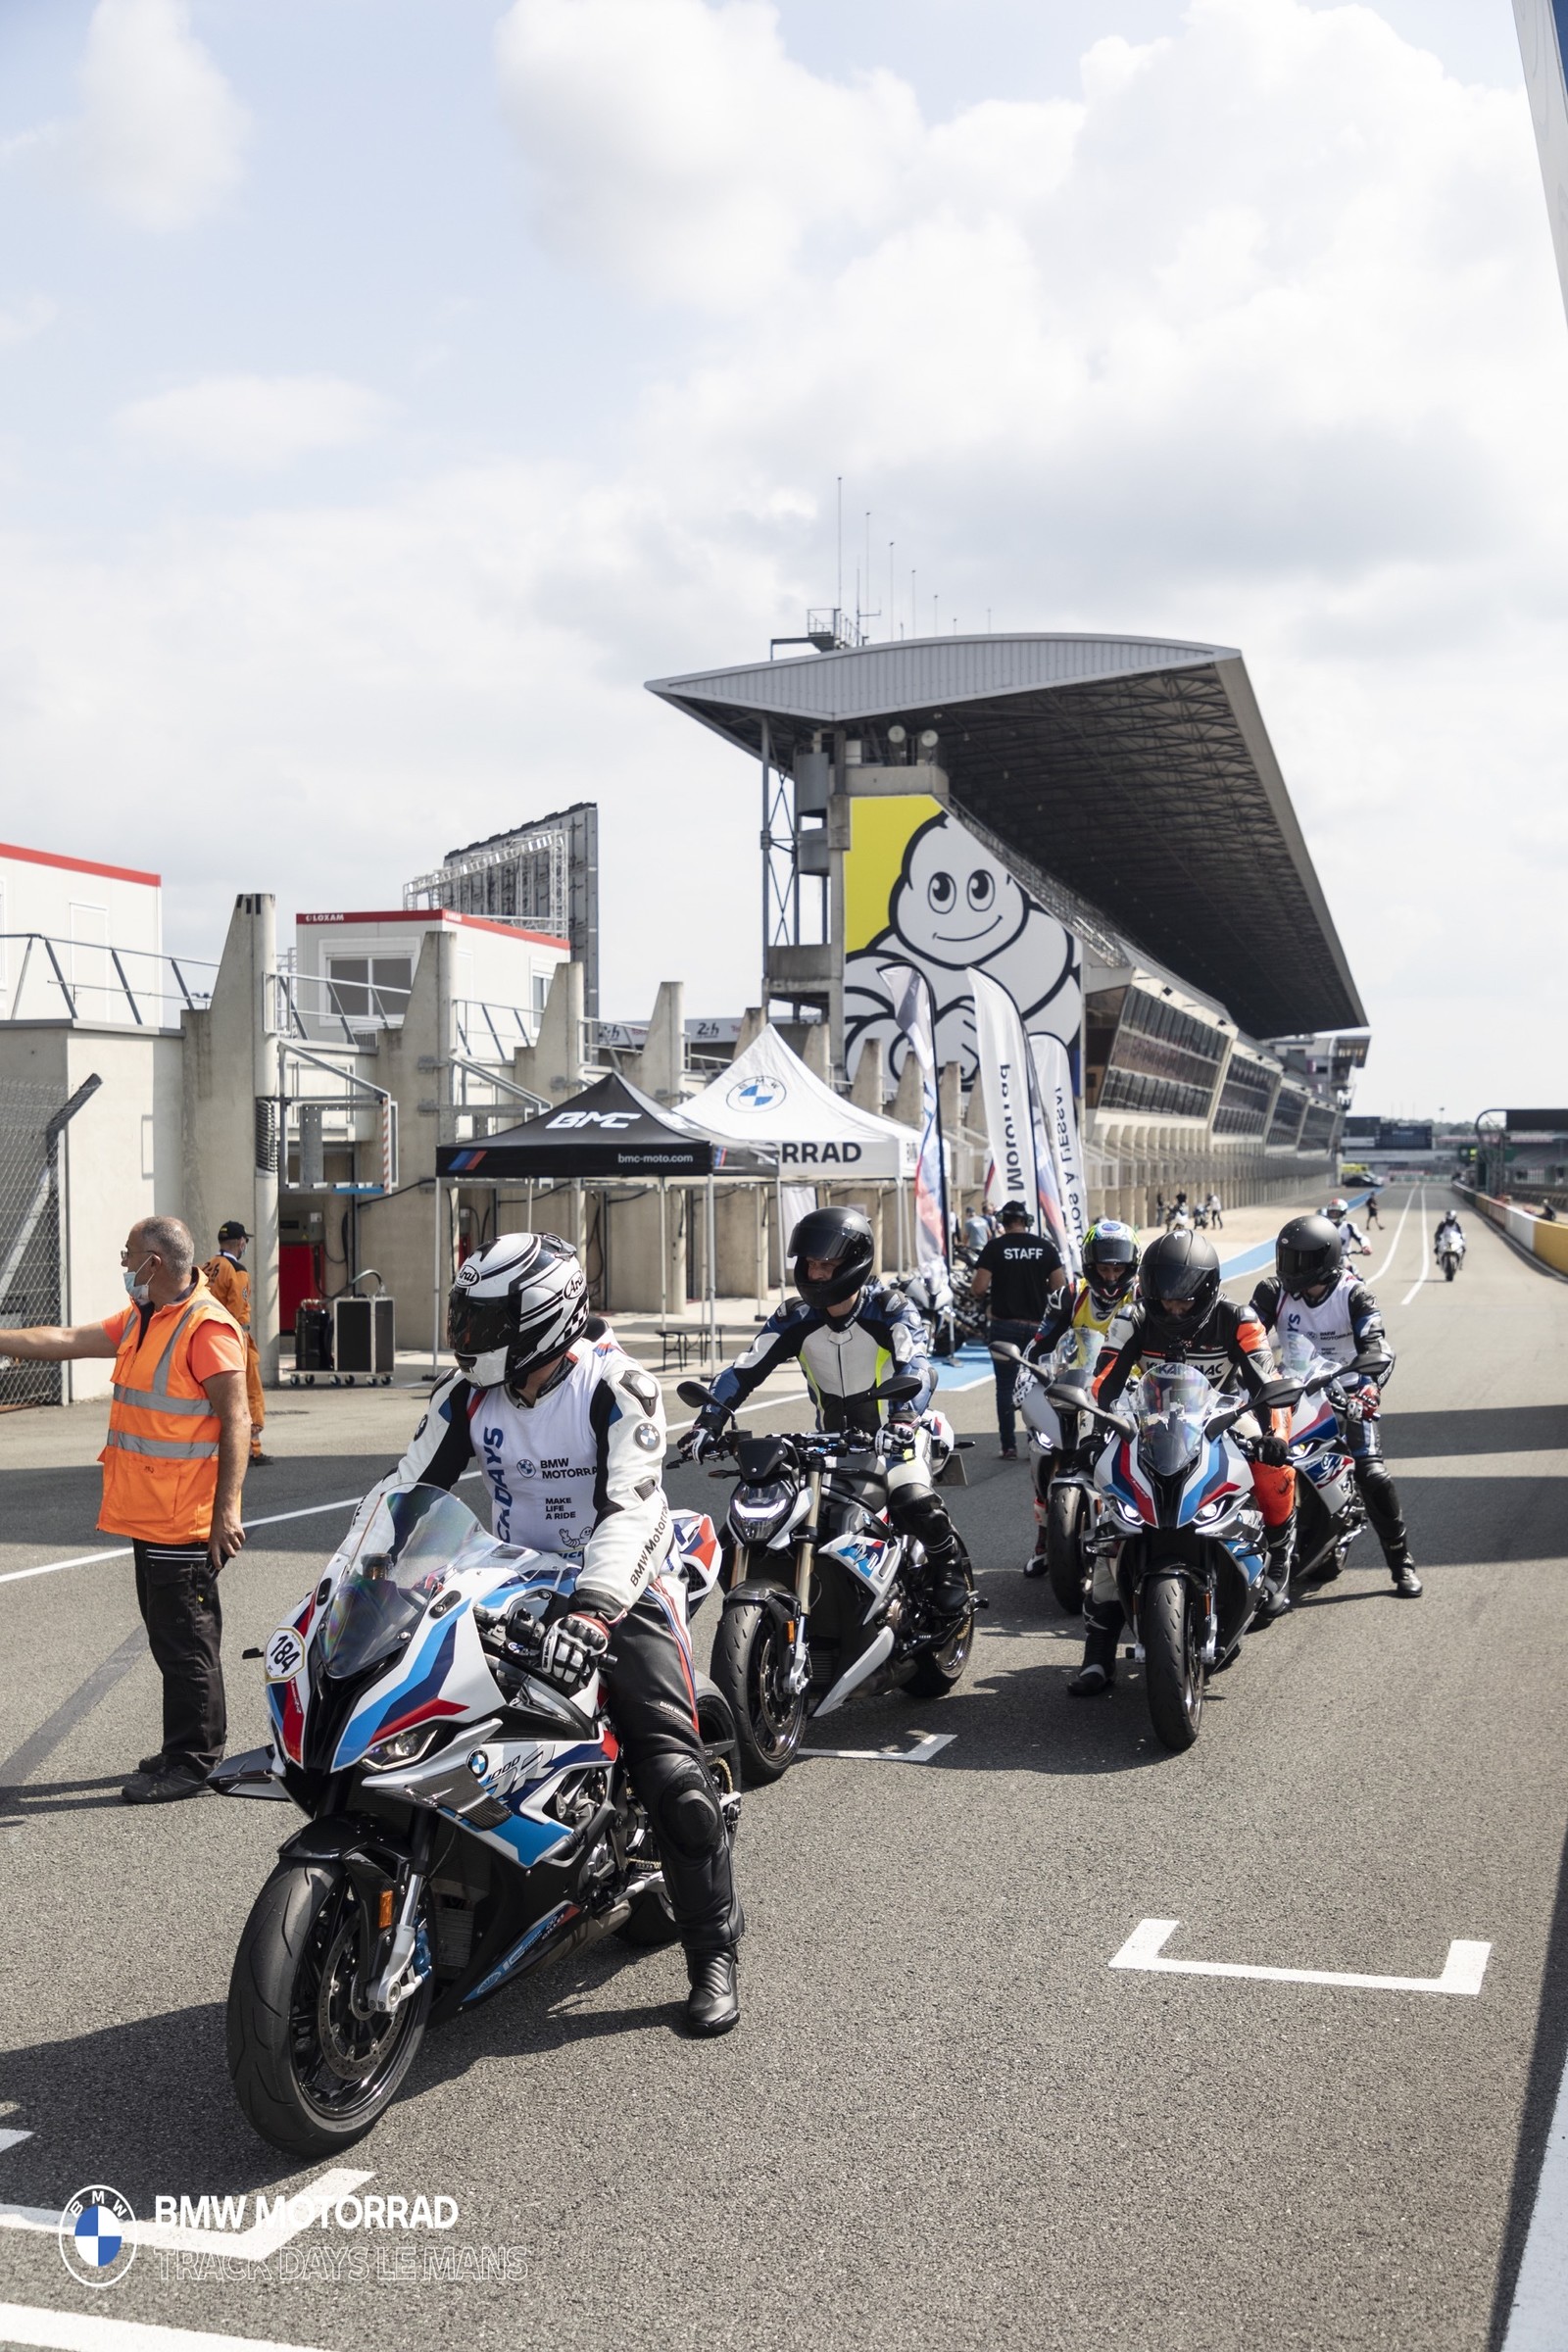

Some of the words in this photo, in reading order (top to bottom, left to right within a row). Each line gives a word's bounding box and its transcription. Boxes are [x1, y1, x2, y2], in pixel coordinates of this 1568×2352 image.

[313, 913, 344, 922] LOXAM
[545, 1111, 642, 1129] BMC
[617, 1153, 694, 1164] bmc-moto.com
[763, 1142, 861, 1164] RRAD
[1004, 1247, 1044, 1260] STAFF
[540, 1458, 569, 1469] BMW
[542, 1466, 598, 1479] MOTORRA
[630, 1550, 649, 1588] BMW
[646, 1500, 669, 1555] Motorra
[270, 1635, 301, 1675] 184
